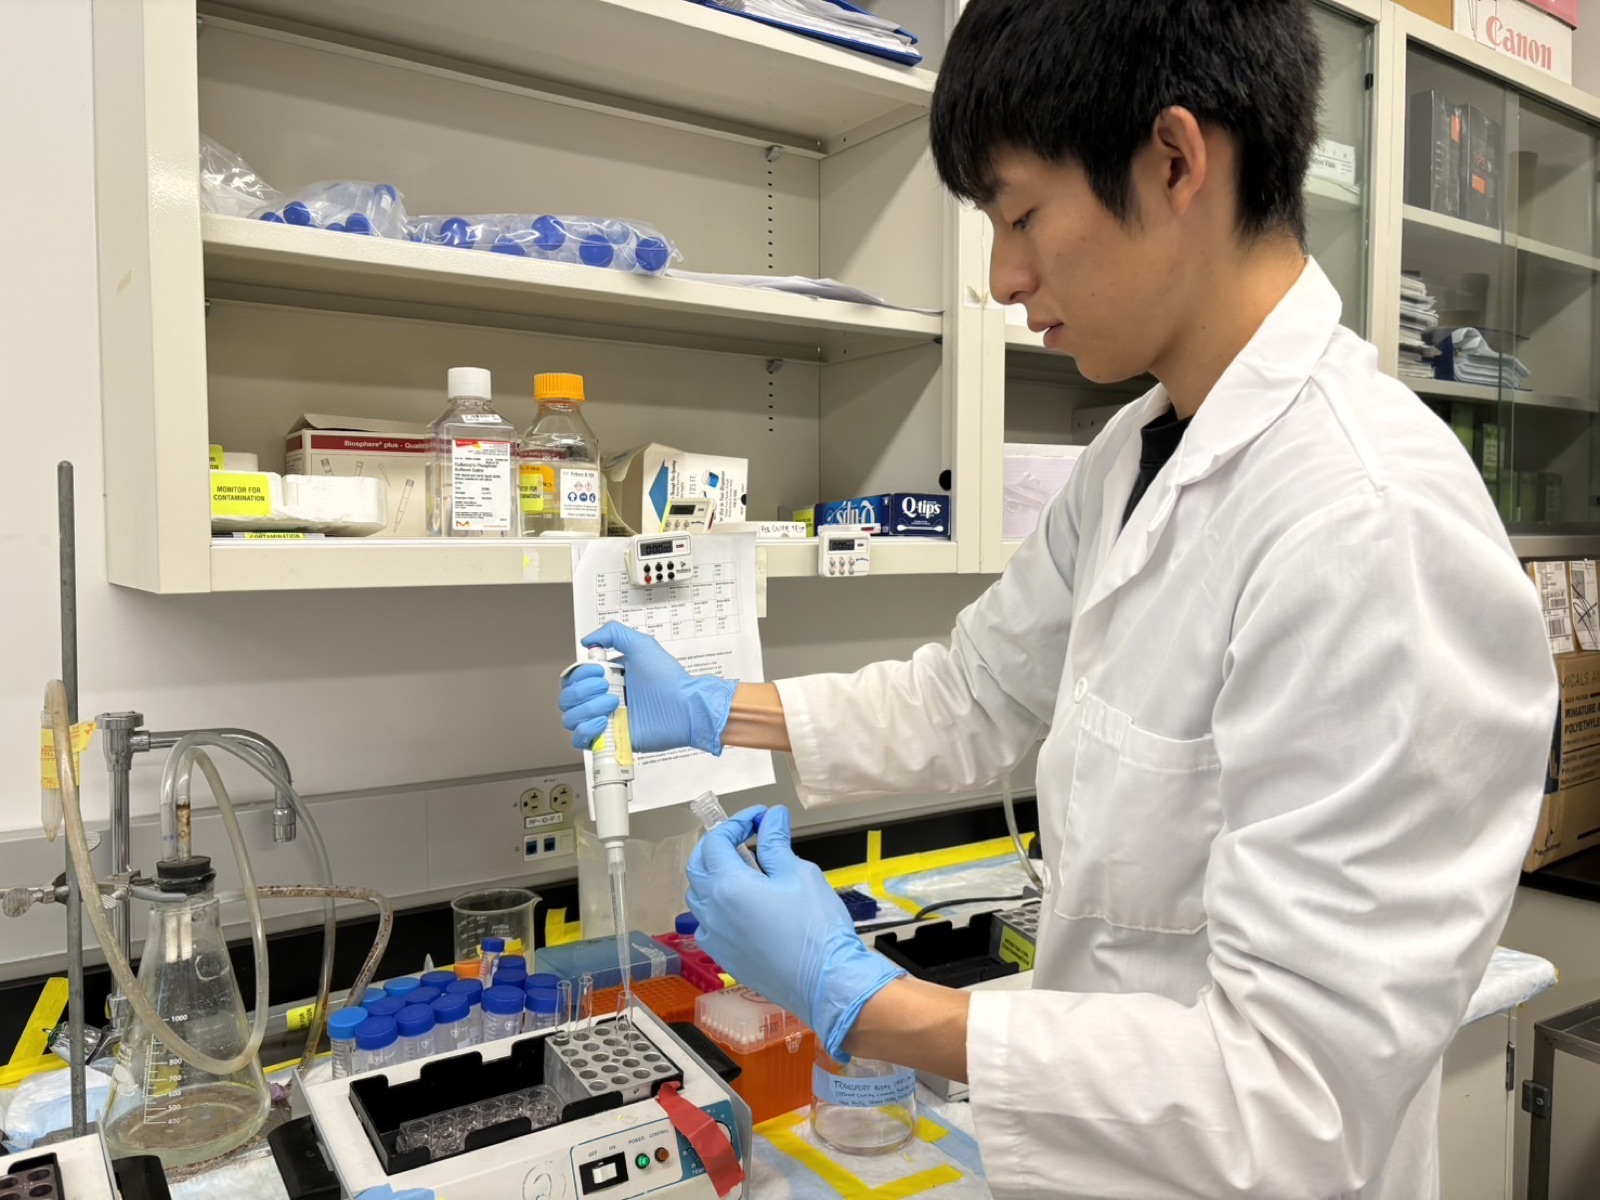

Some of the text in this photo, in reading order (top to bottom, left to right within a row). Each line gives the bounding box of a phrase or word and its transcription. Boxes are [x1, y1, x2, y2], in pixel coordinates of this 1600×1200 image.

[1485, 15, 1552, 71] Canon
[216, 486, 247, 494] MONITOR
[902, 496, 942, 519] Q-tips
[1565, 702, 1596, 719] MINIATURE
[171, 1014, 188, 1022] 1000
[628, 1129, 670, 1145] POWER CONTROL
[588, 1150, 598, 1158] OFF
